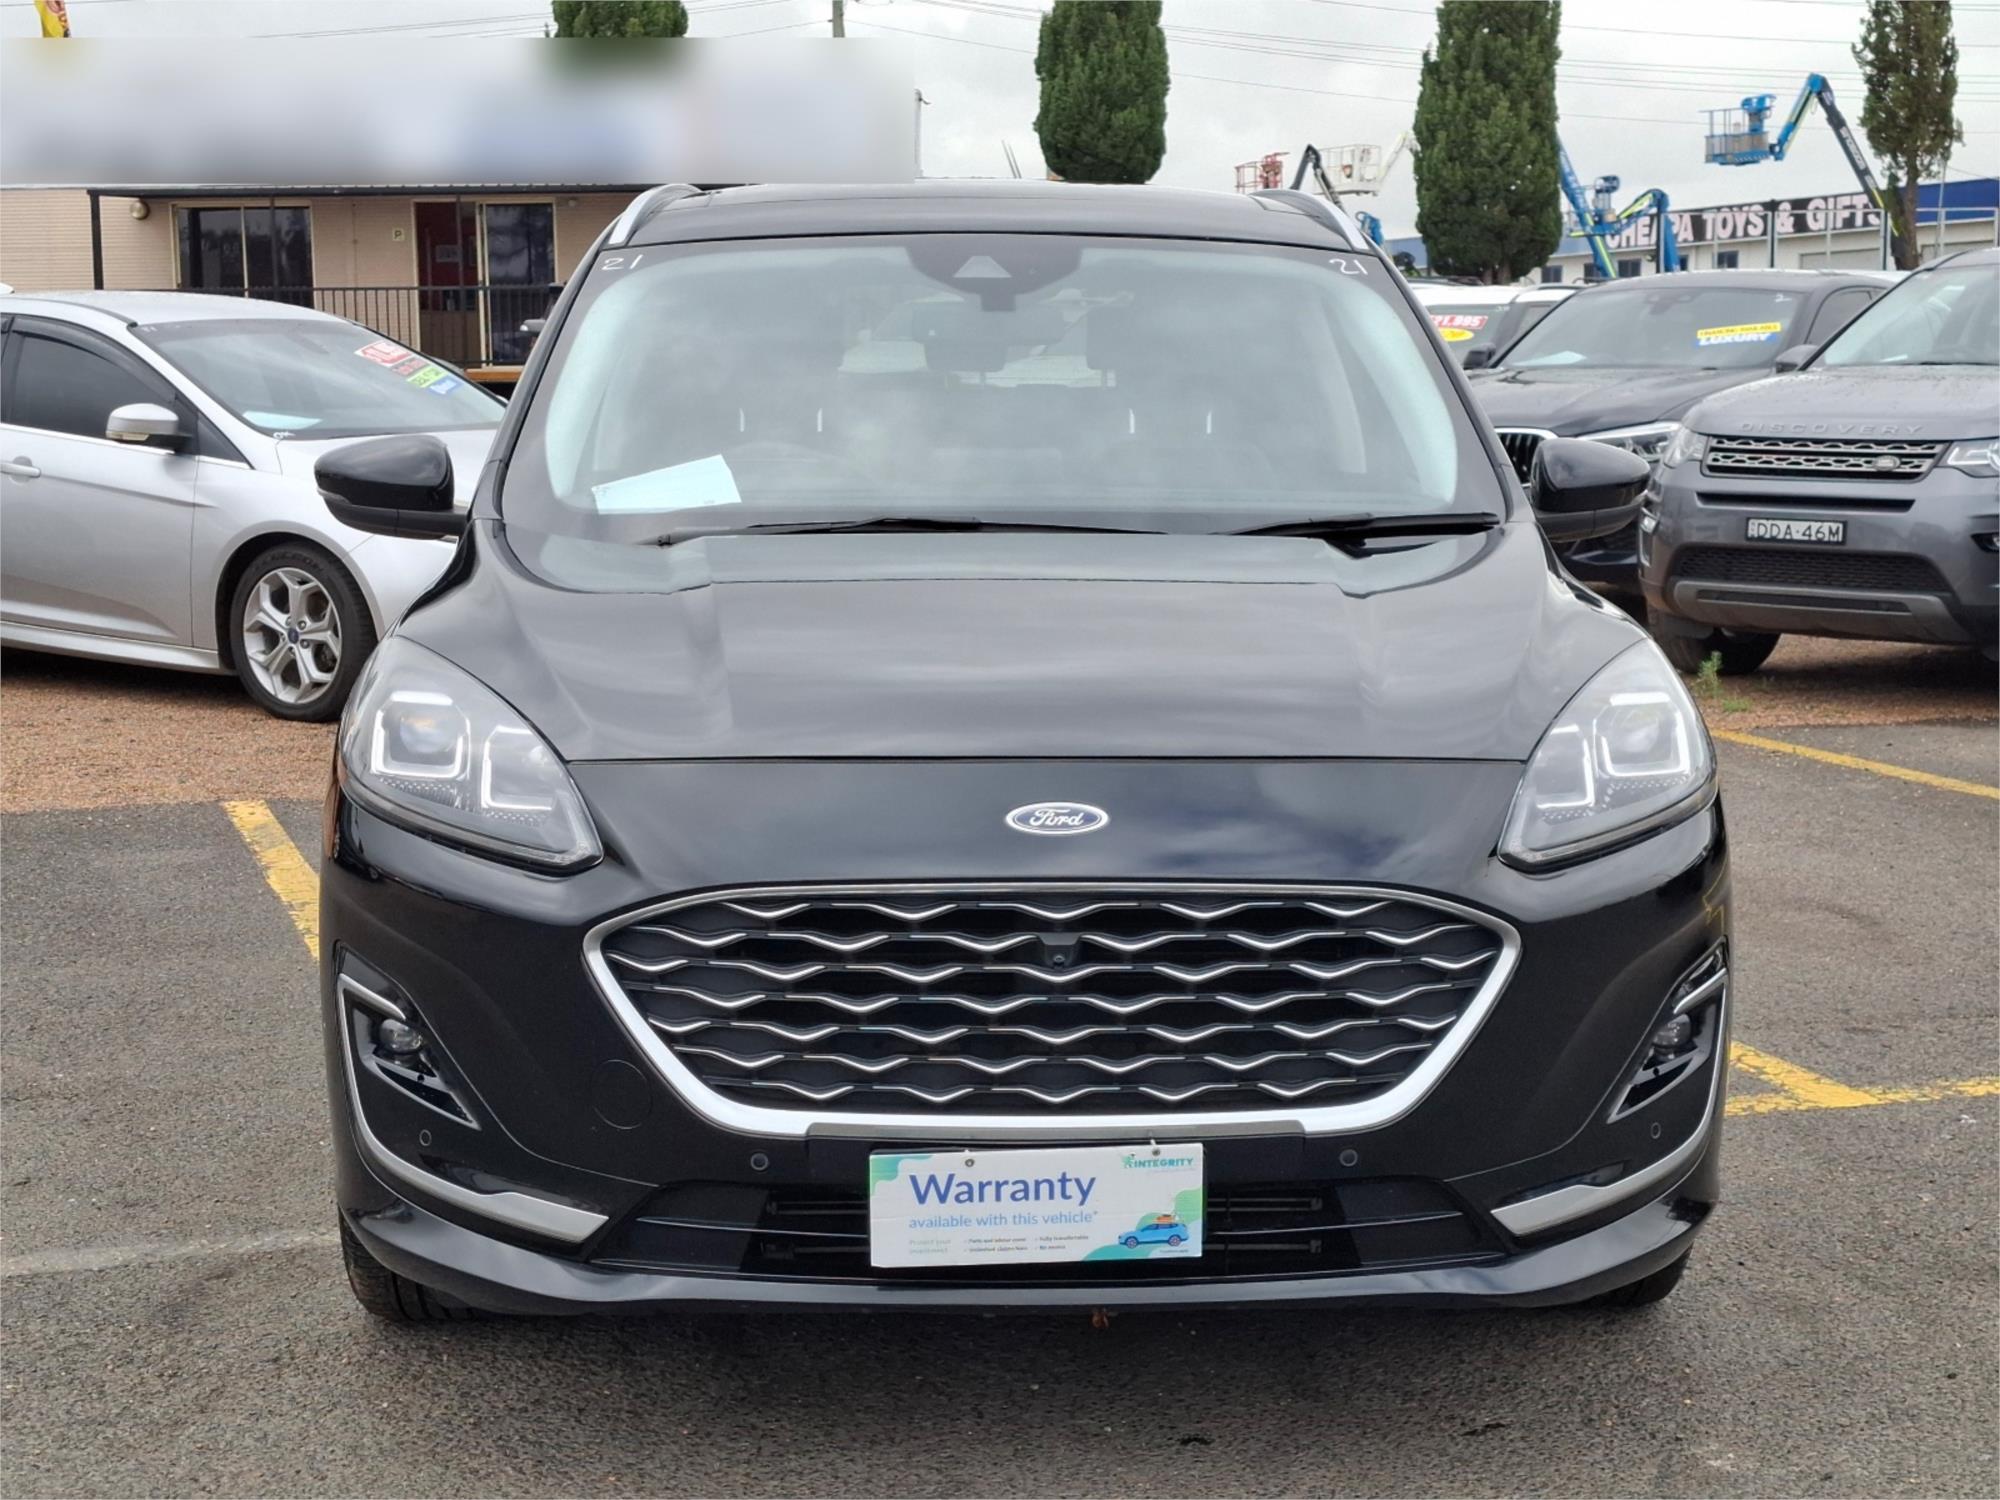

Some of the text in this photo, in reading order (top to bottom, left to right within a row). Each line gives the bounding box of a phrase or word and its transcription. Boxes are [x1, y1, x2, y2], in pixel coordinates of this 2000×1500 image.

[1701, 204, 1765, 240] TOYS
[1777, 201, 1794, 234] &
[601, 254, 643, 270] 21
[1329, 257, 1369, 275] 21
[1740, 423, 1923, 436] DISCOVERY
[1029, 807, 1085, 826] Ford
[1134, 1157, 1194, 1169] INTEGRITY
[909, 1171, 1096, 1206] Warranty
[909, 1215, 972, 1230] available
[976, 1213, 1008, 1227] with
[1012, 1212, 1038, 1226] this
